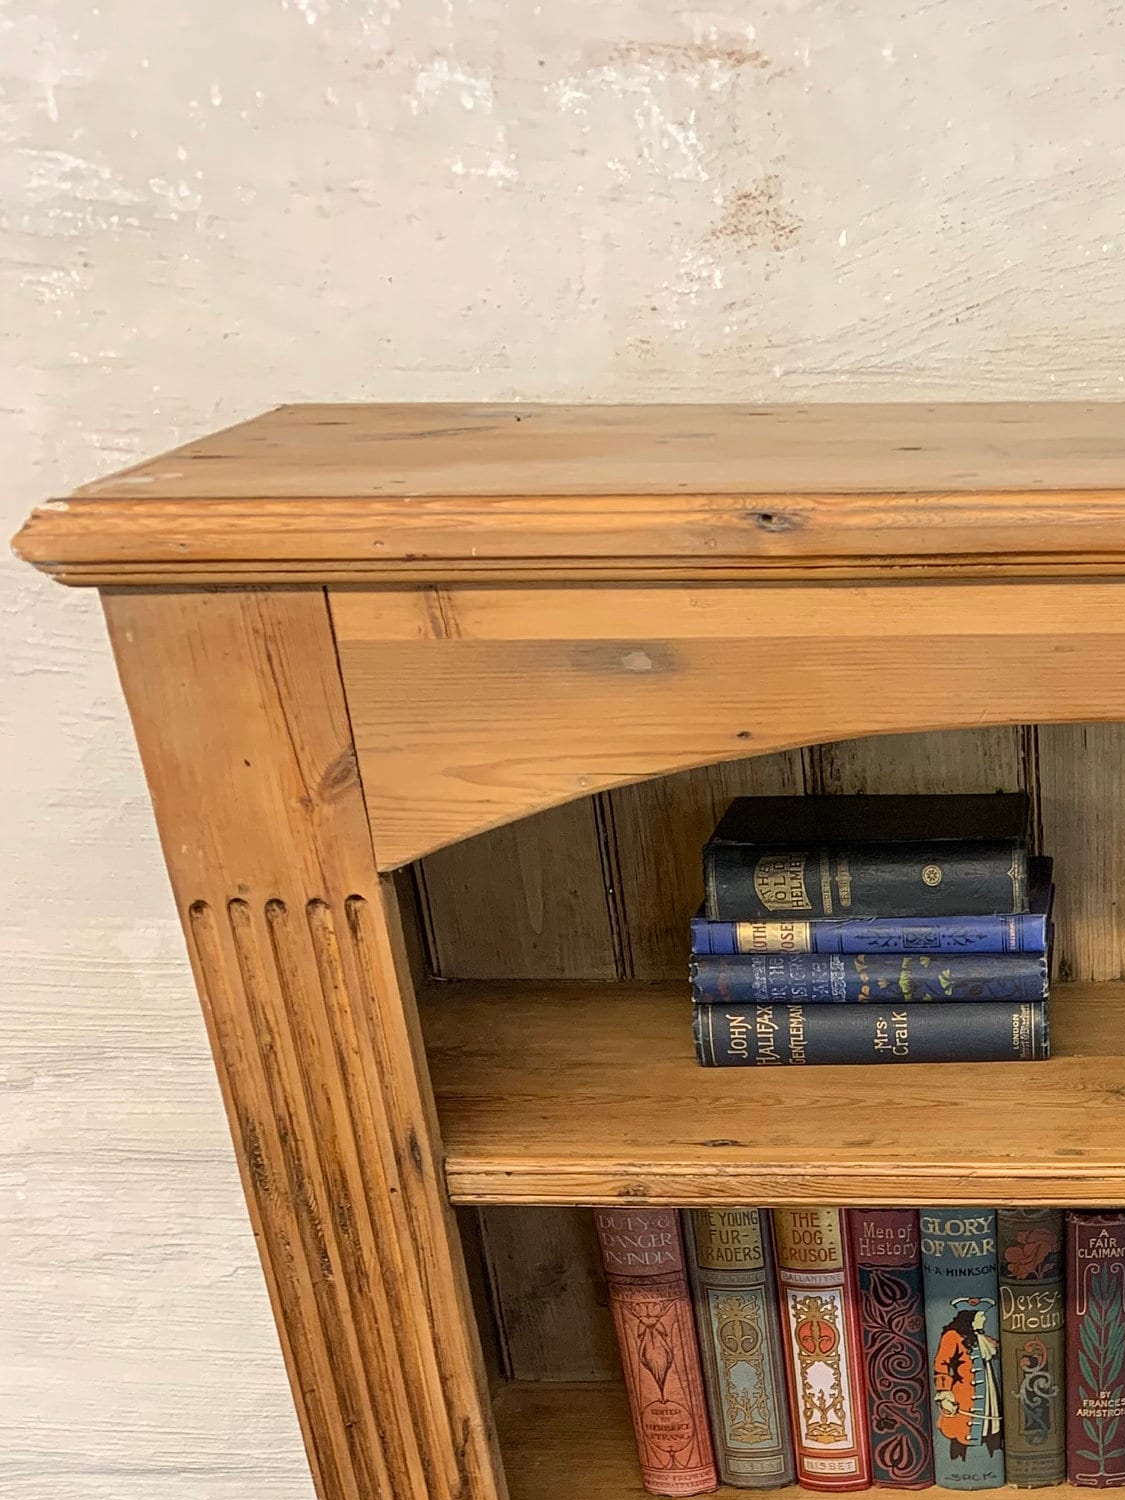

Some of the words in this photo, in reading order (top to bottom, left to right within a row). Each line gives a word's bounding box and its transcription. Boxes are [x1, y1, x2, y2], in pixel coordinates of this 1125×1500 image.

[757, 863, 773, 899] THE
[774, 860, 787, 901] OLD
[789, 853, 805, 909] HELMET
[725, 1013, 753, 1059] JOHN
[755, 1004, 784, 1066] HALIFAX
[786, 1004, 808, 1065] GENTLEMAN
[892, 1010, 908, 1057] Craik
[1012, 1013, 1020, 1051] LONDON
[719, 1210, 758, 1227] YOUNG
[790, 1211, 821, 1228] THE
[920, 1215, 994, 1237] GLORY
[708, 1229, 750, 1245] FUR-
[791, 1229, 824, 1246] DOG
[863, 1221, 896, 1240] Men
[897, 1223, 913, 1239] of
[1099, 1228, 1109, 1238] A
[601, 1232, 673, 1249] DANGER
[858, 1238, 917, 1259] History
[920, 1239, 947, 1257] OF
[949, 1239, 996, 1258] WAR
[1089, 1237, 1118, 1249] FAIR
[700, 1245, 762, 1263] TRADERS
[781, 1246, 838, 1264] CRUSOE
[782, 1273, 842, 1285] BALLANTYNE
[924, 1266, 932, 1275] H
[934, 1267, 943, 1276] A
[946, 1264, 997, 1278] HINKSON
[1098, 1390, 1112, 1399] BY
[645, 1422, 691, 1432] HERBERT
[649, 1432, 691, 1442] STRANG
[805, 1460, 854, 1472] NISBET
